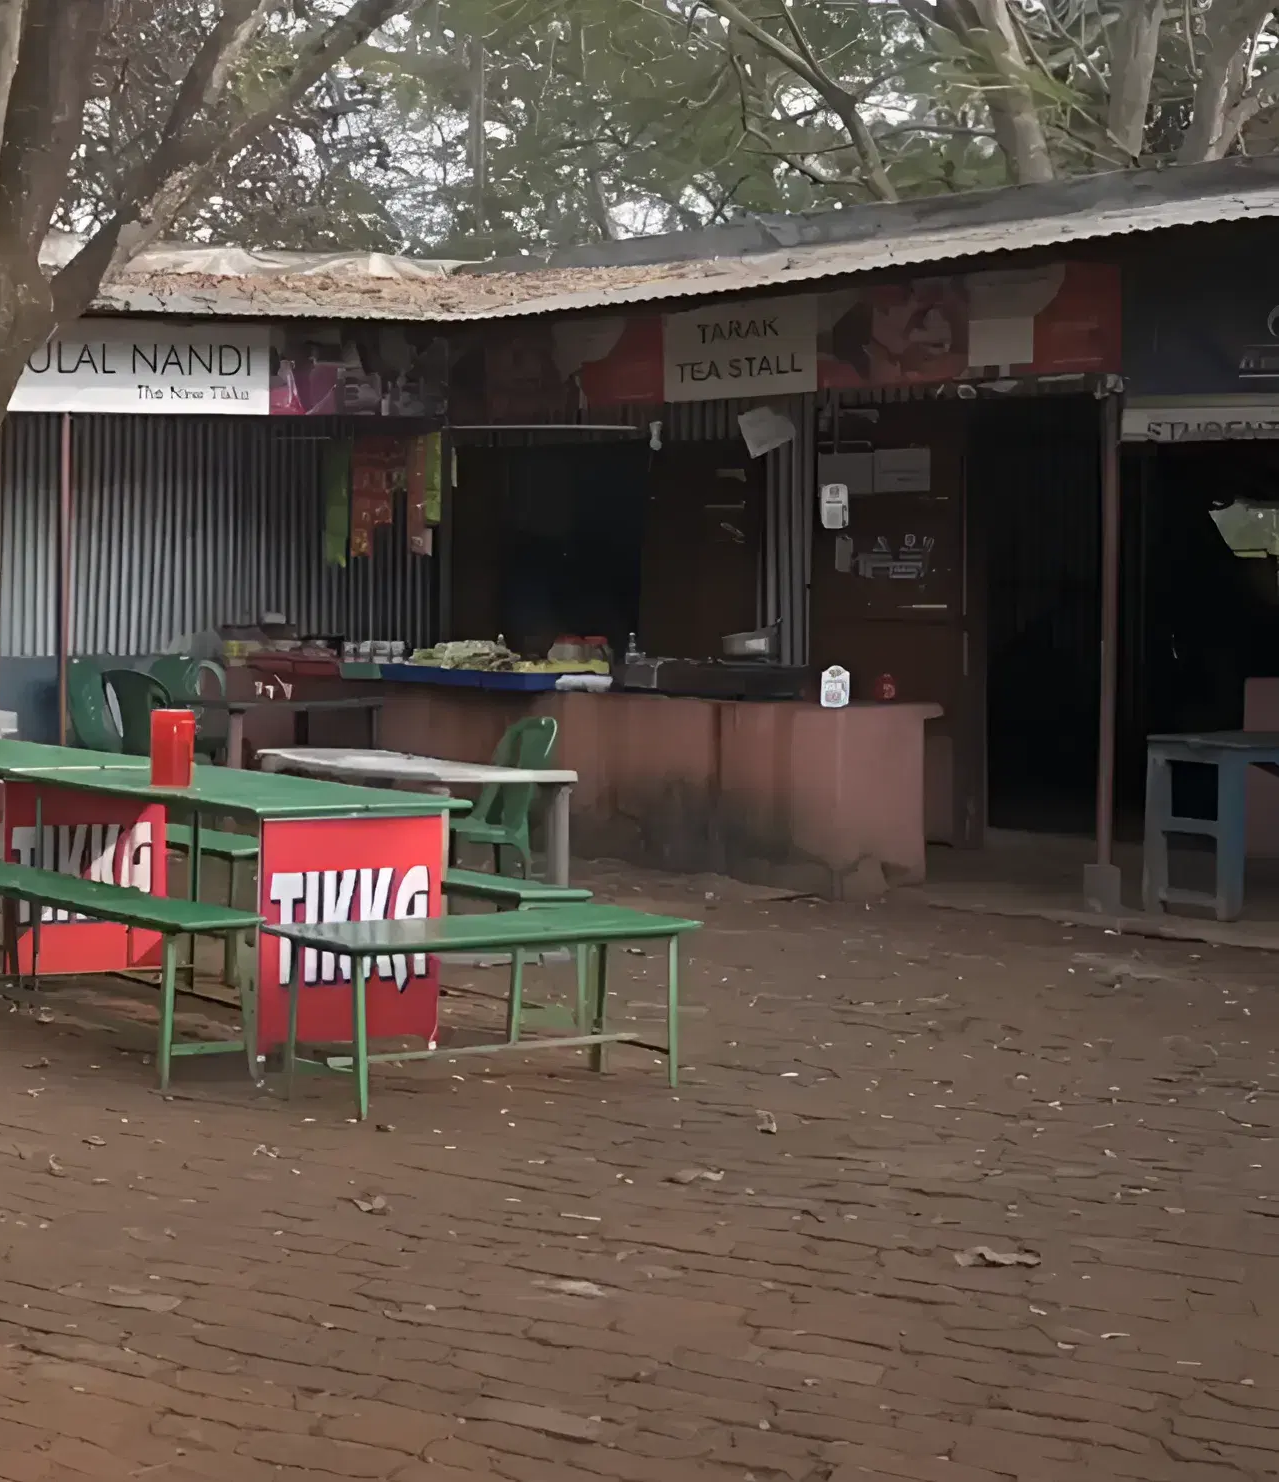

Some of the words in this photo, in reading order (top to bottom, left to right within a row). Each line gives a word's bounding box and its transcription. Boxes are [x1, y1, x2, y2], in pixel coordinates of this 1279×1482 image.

[697, 316, 779, 344] TARAK
[26, 341, 117, 374] ULAL
[132, 344, 251, 376] NANDI
[675, 360, 723, 384] TEA
[728, 352, 803, 378] STALL
[270, 864, 431, 994] TIKKA
